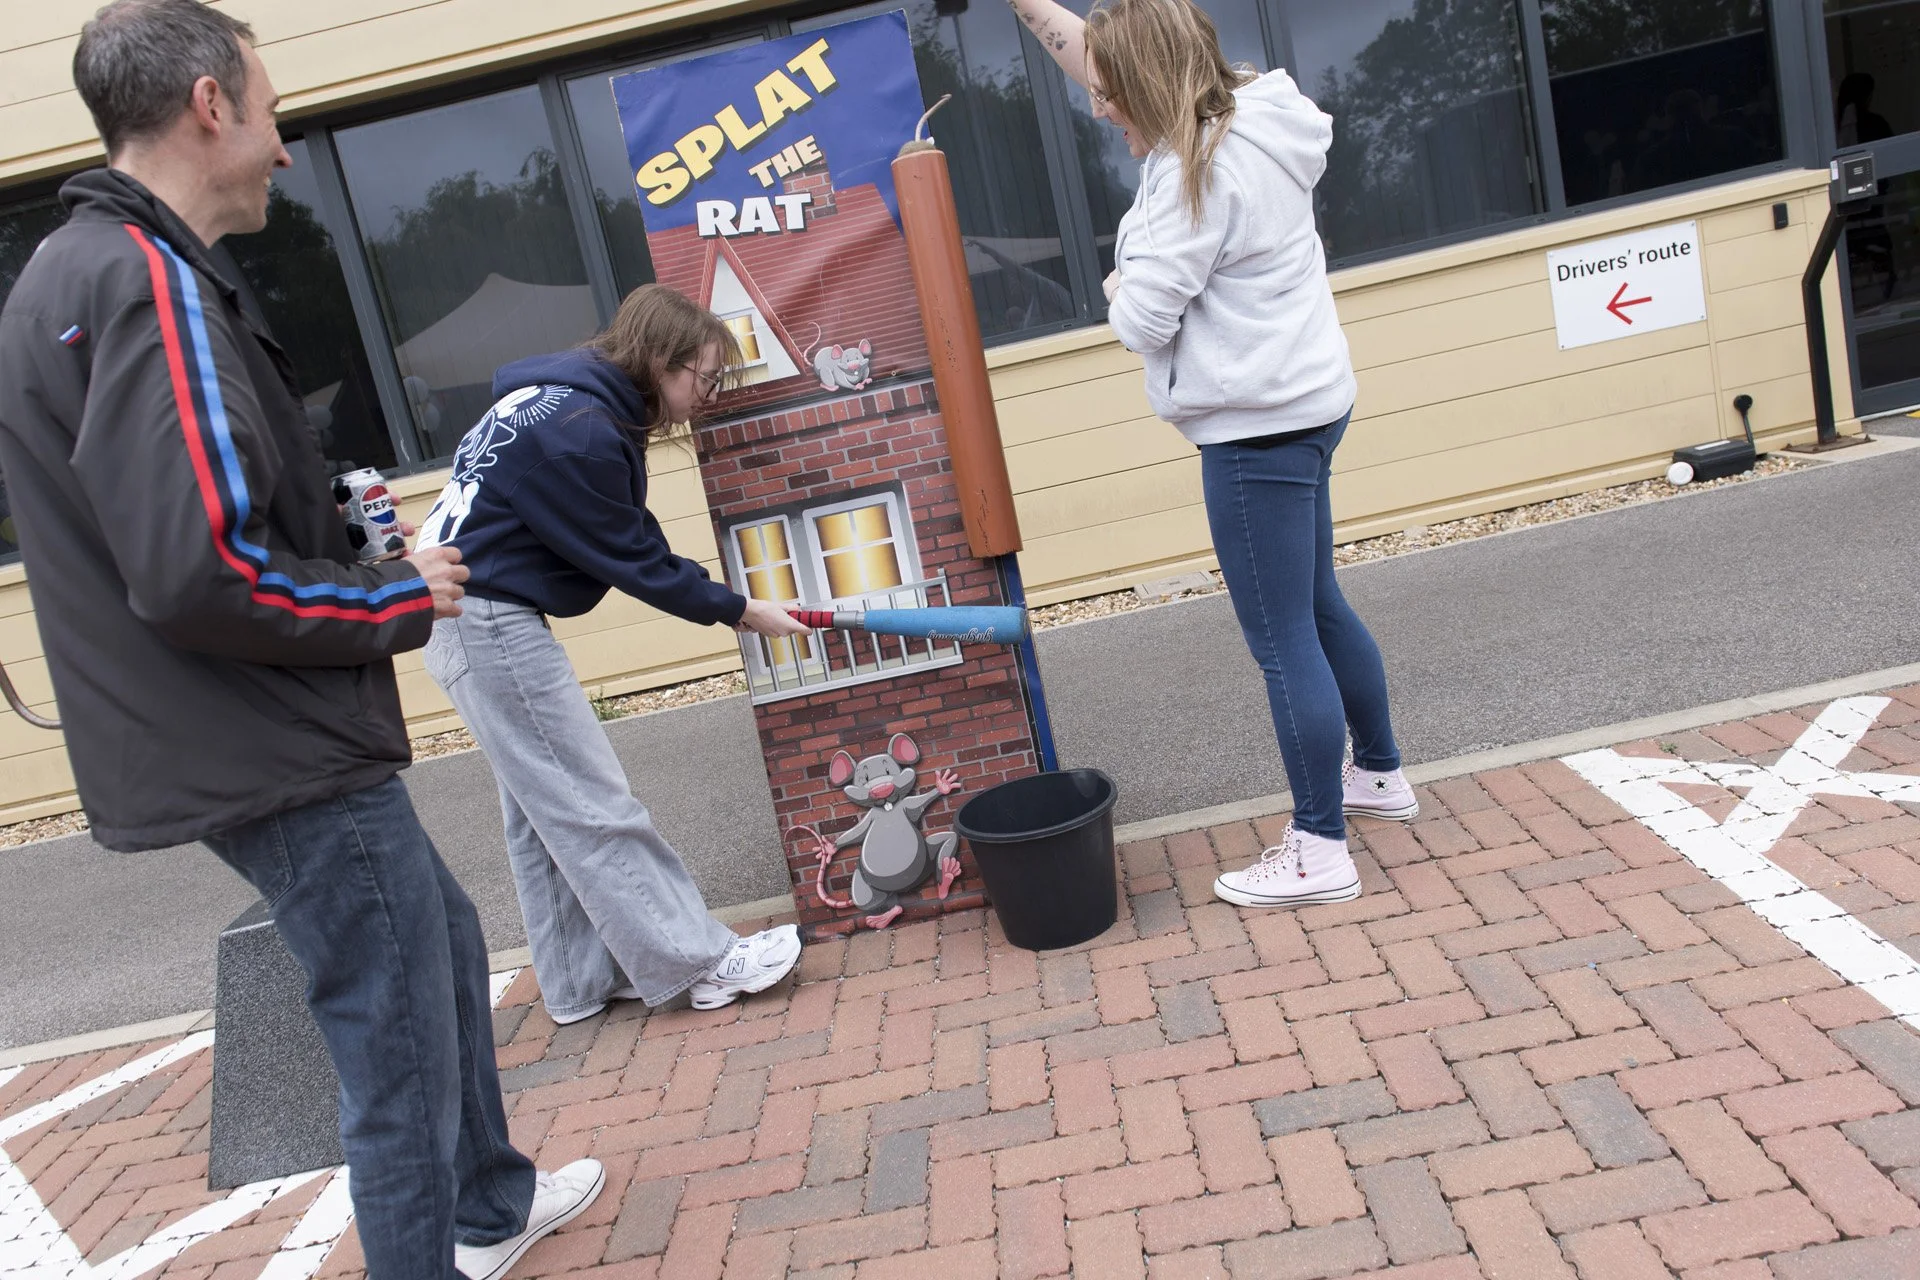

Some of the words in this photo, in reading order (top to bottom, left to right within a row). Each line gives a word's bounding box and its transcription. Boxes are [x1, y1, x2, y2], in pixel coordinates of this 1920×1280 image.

[636, 38, 836, 205] SPLAT
[748, 135, 823, 188] THE
[696, 193, 811, 237] RAT
[1557, 249, 1631, 282] Drivers'
[1638, 241, 1691, 264] route
[363, 498, 393, 513] PEPS
[727, 957, 745, 975] N
